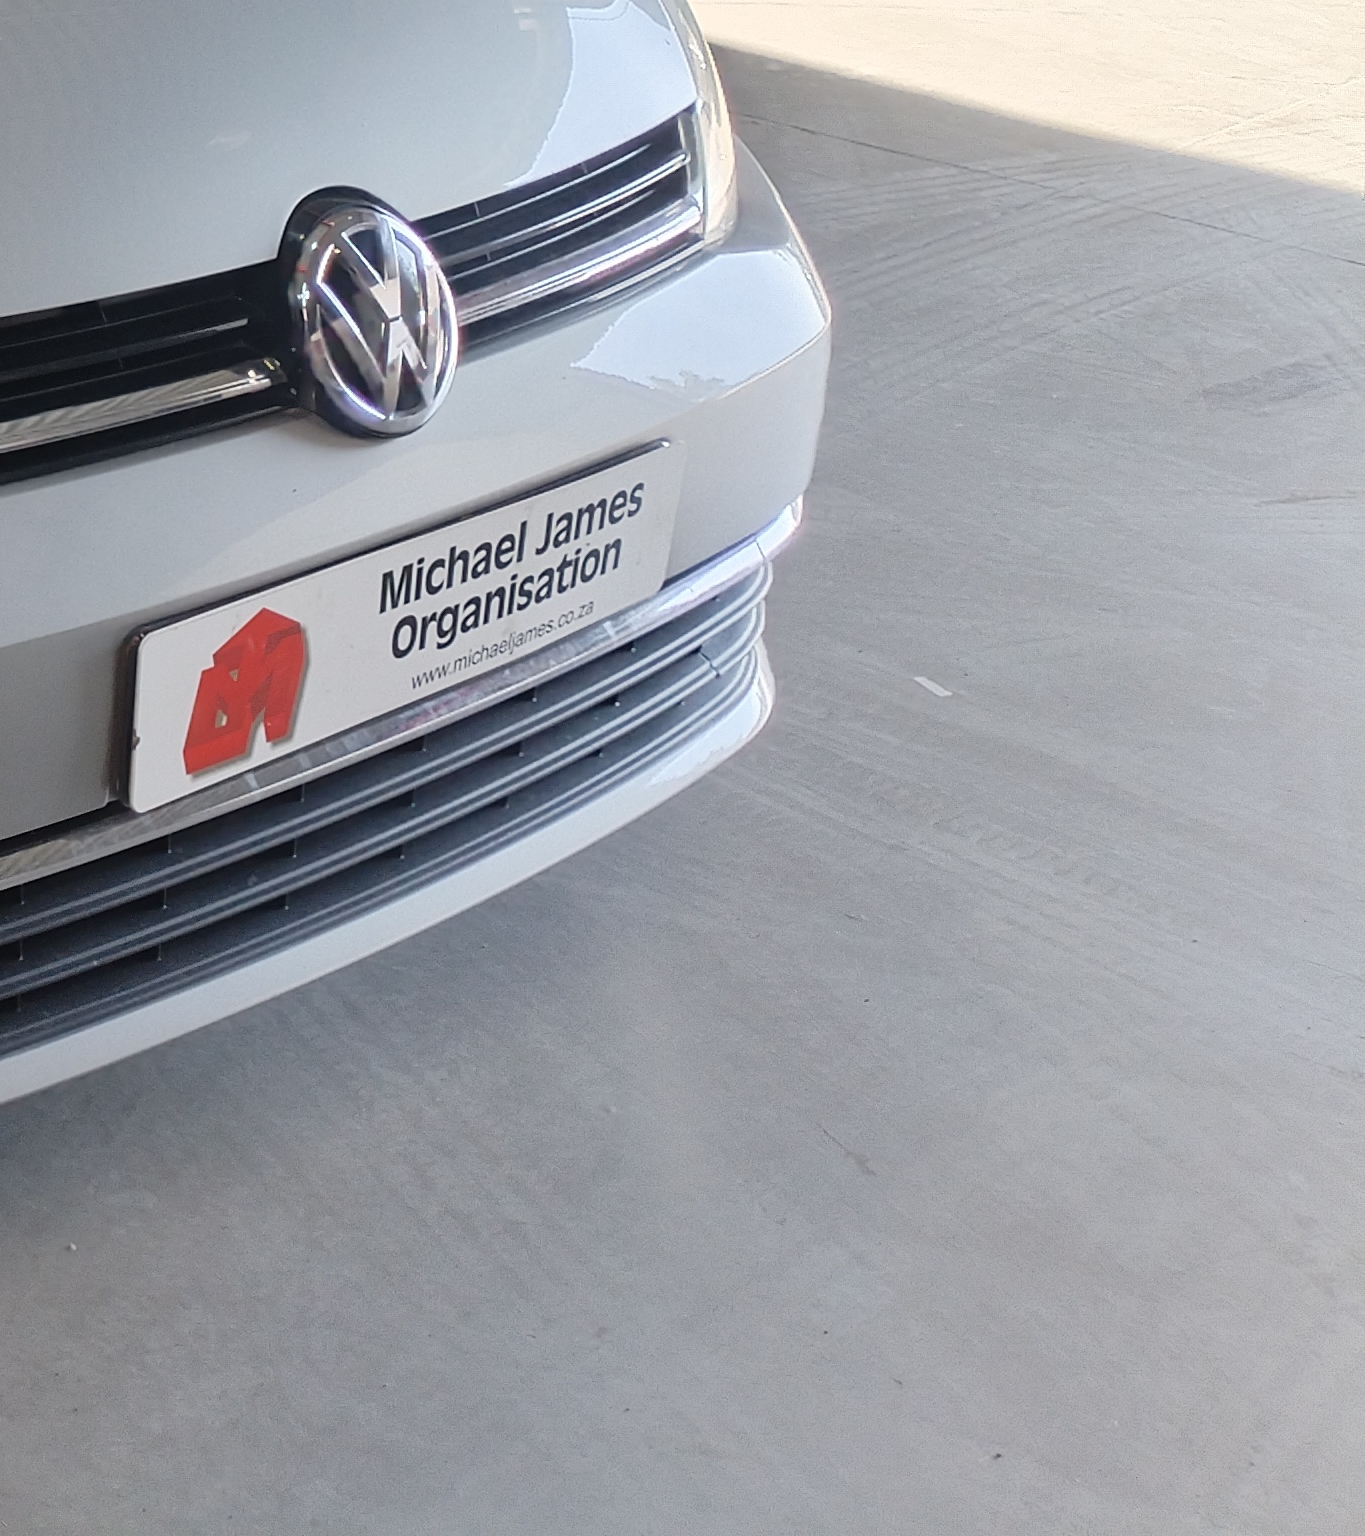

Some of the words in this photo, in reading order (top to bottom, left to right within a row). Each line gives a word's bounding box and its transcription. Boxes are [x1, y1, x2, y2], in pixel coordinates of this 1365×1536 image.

[378, 521, 528, 614] Michael
[534, 480, 645, 556] James
[390, 537, 622, 659] Organisation
[411, 599, 595, 691] www.michaeljames.co.za
